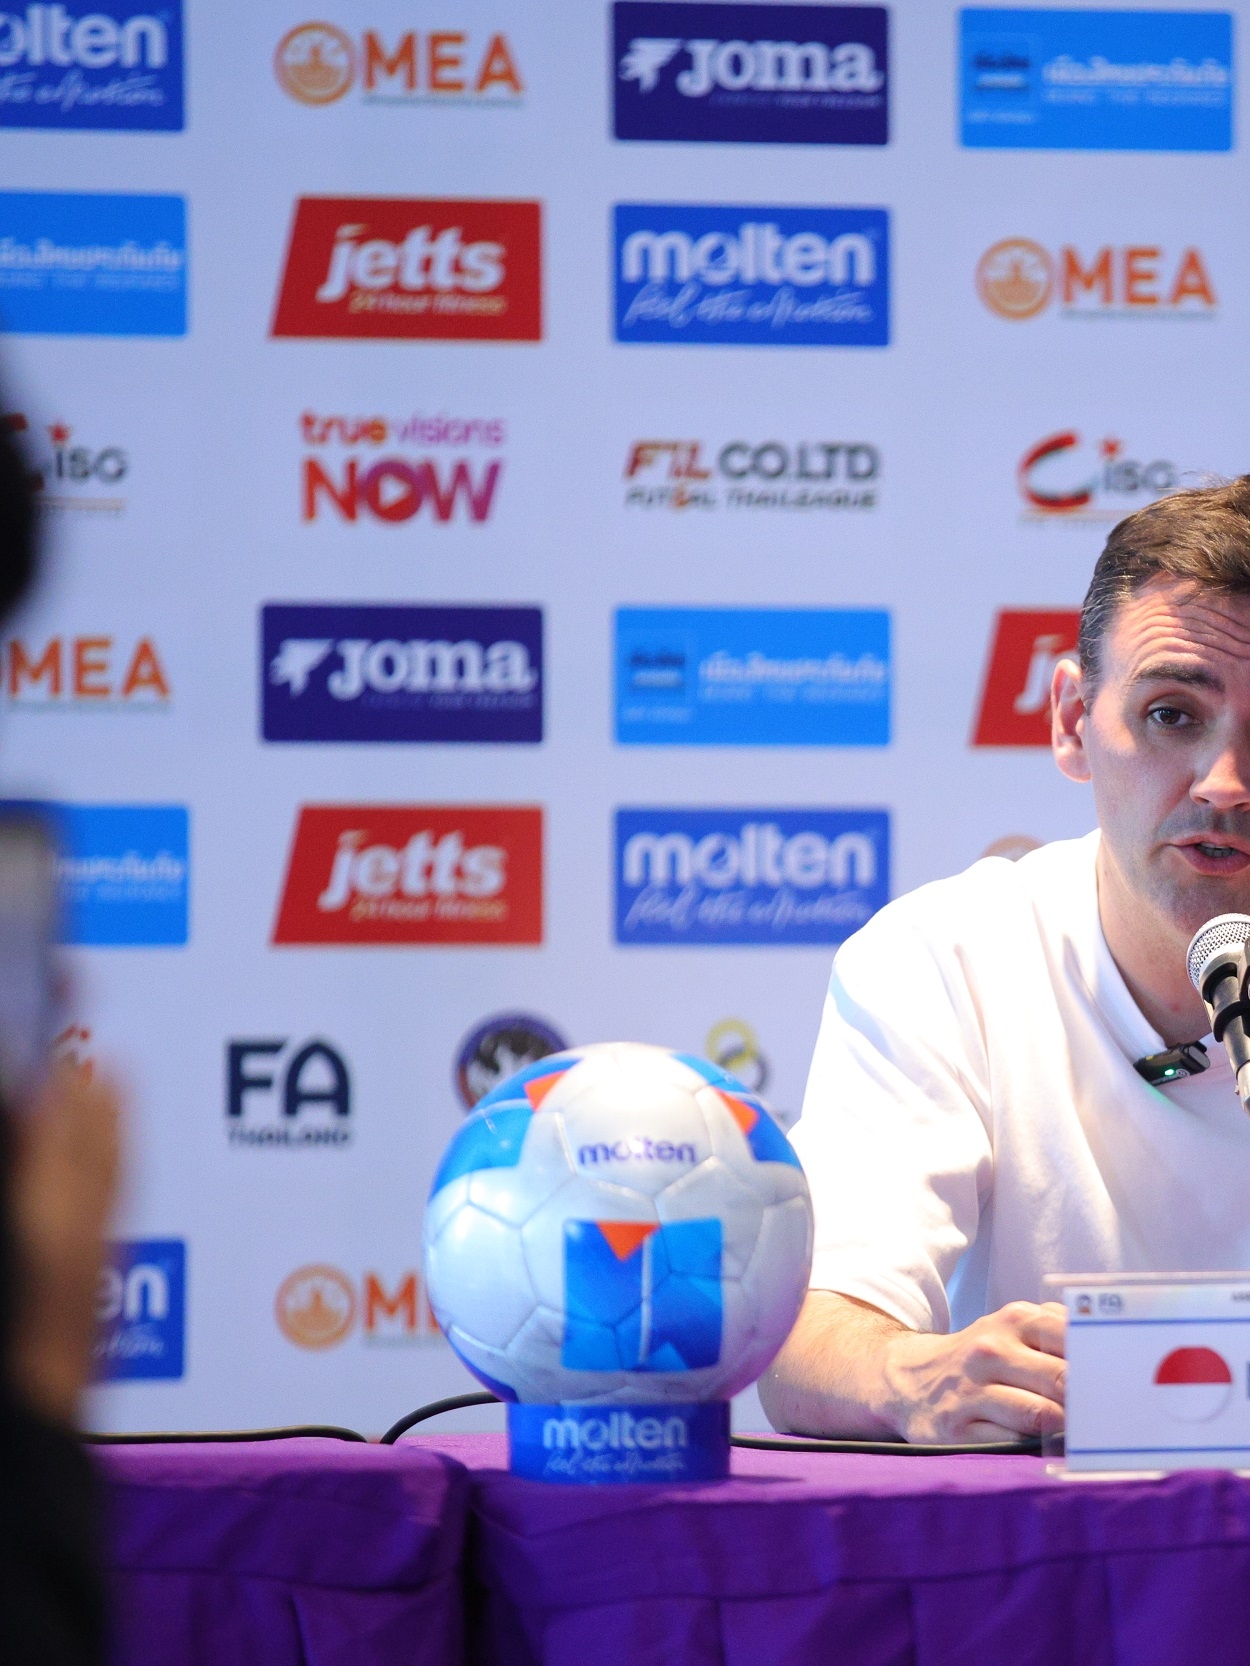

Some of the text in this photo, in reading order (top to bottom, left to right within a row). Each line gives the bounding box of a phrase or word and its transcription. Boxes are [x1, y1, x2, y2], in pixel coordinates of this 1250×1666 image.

[0, 4, 167, 67] olten
[361, 30, 523, 93] MEA
[316, 224, 506, 302] jetts
[622, 222, 875, 285] molten
[1059, 246, 1216, 307] MEA
[303, 457, 504, 524] NOW
[7, 636, 169, 698] MEA
[318, 831, 507, 911] jetts
[623, 823, 876, 887] molten
[226, 1037, 351, 1119] FA
[543, 1411, 687, 1450] molten
